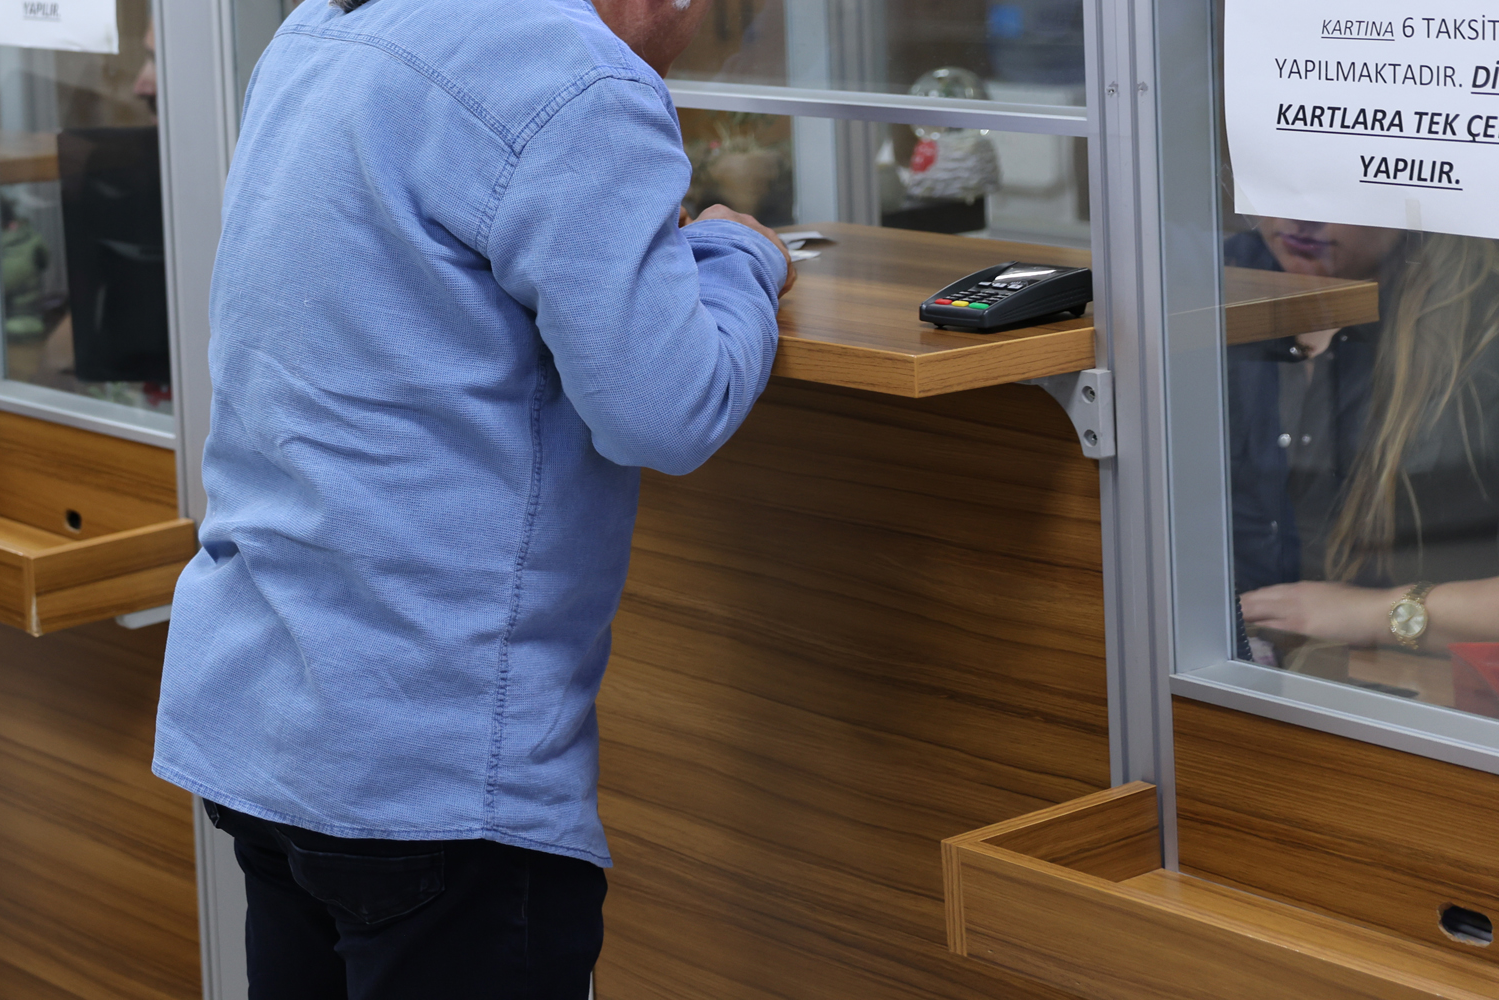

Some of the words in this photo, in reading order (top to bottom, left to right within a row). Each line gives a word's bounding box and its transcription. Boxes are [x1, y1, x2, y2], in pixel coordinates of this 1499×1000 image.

[1321, 18, 1395, 37] KARTINA
[1402, 16, 1415, 38] 6
[1422, 14, 1499, 41] TAKSİT
[1274, 57, 1463, 88] YAPILMAKTADIR.
[1276, 103, 1404, 133] KARTLARA
[1414, 111, 1460, 136] TEK
[1466, 114, 1499, 142] ÇE
[1359, 155, 1461, 185] YAPILIR.
